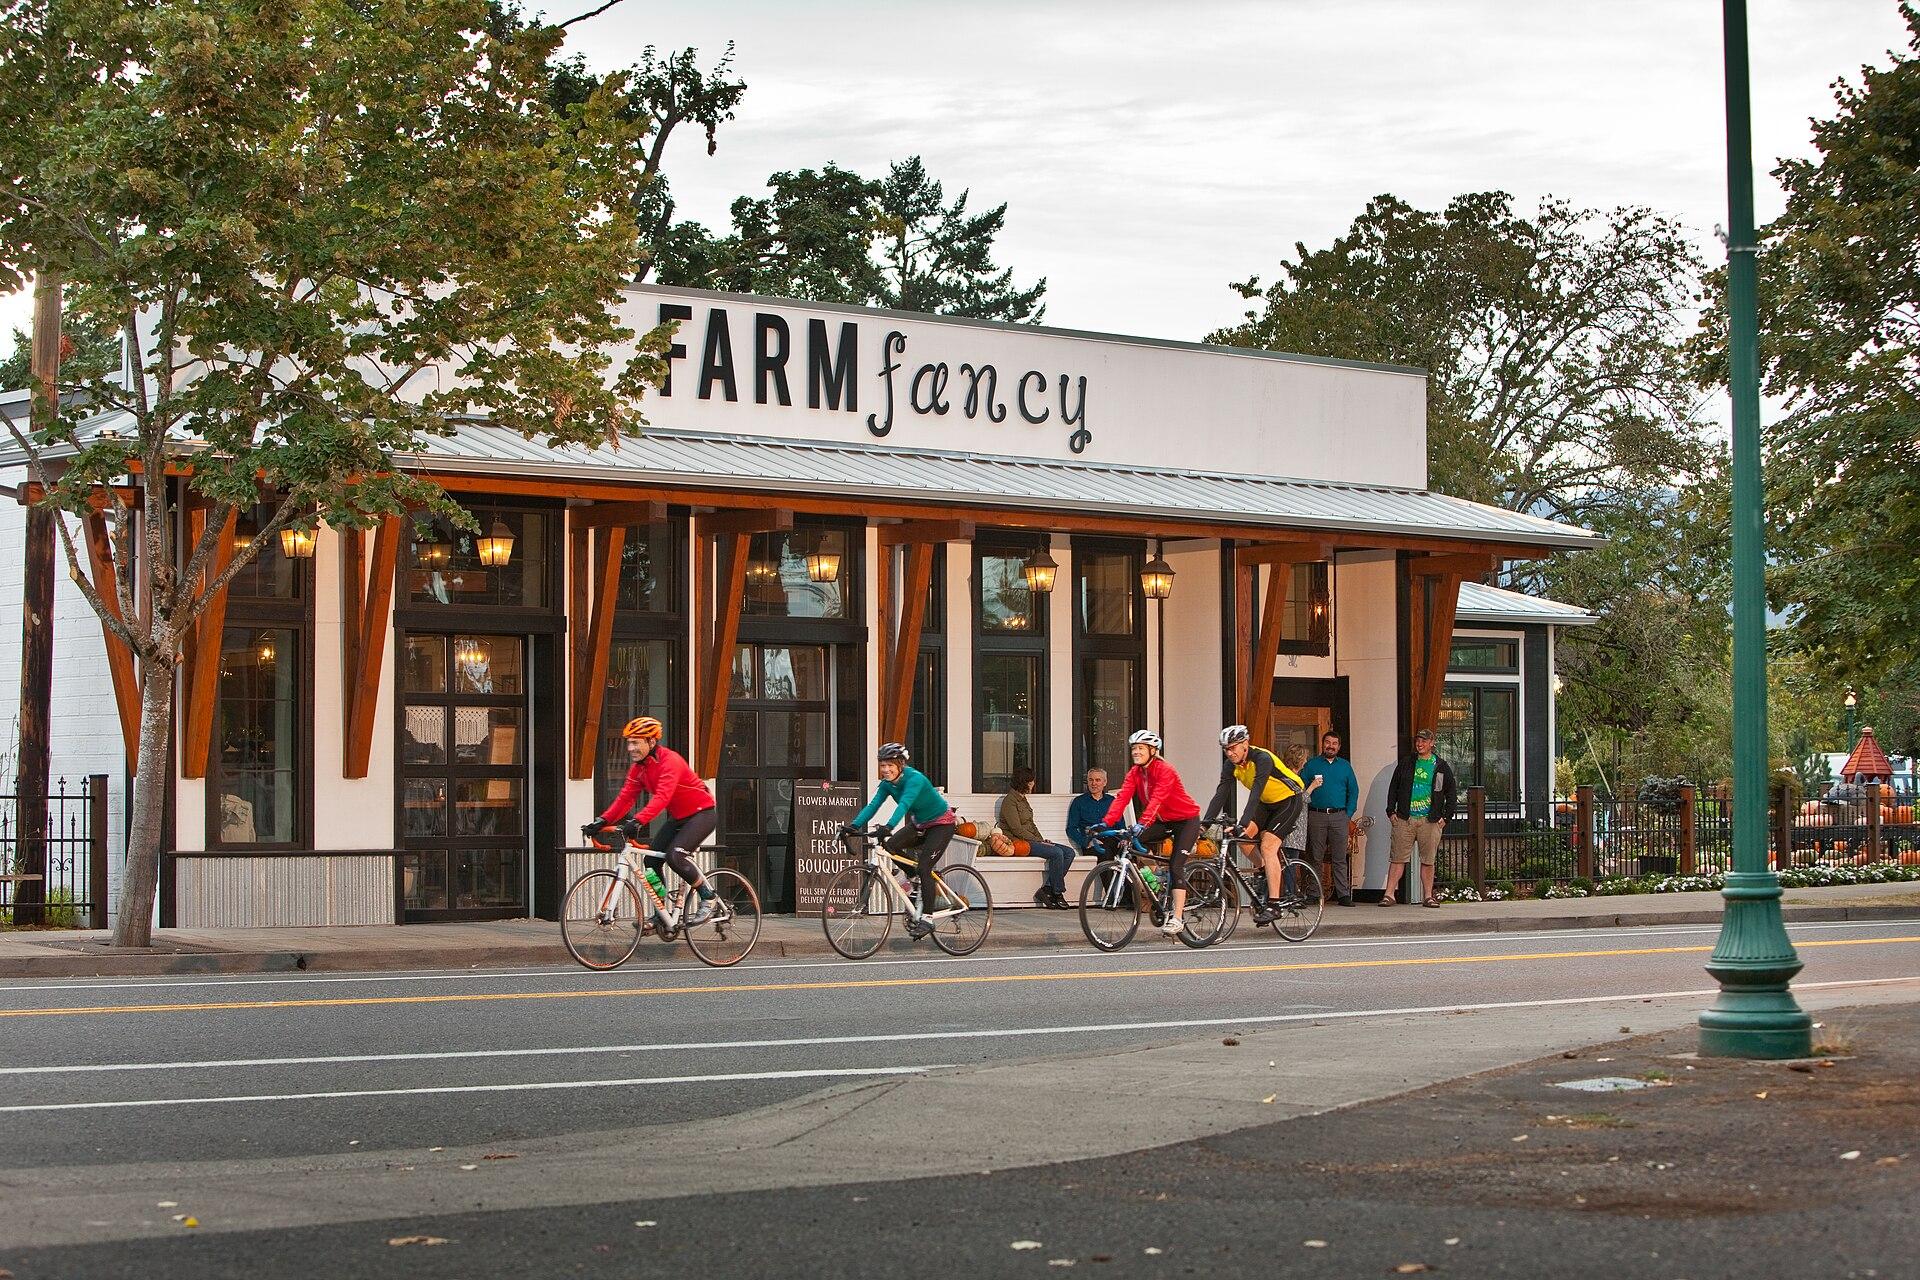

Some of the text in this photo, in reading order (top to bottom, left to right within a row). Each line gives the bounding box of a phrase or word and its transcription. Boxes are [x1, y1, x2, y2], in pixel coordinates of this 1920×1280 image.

[659, 303, 1092, 454] FARM fancy
[798, 796, 858, 807] FLOWER MARKET
[811, 839, 847, 854] FRESH
[798, 858, 860, 874] BOUQUETS
[799, 887, 859, 896] FULL SERVCE FLORIST
[800, 896, 826, 904] DELIVER
